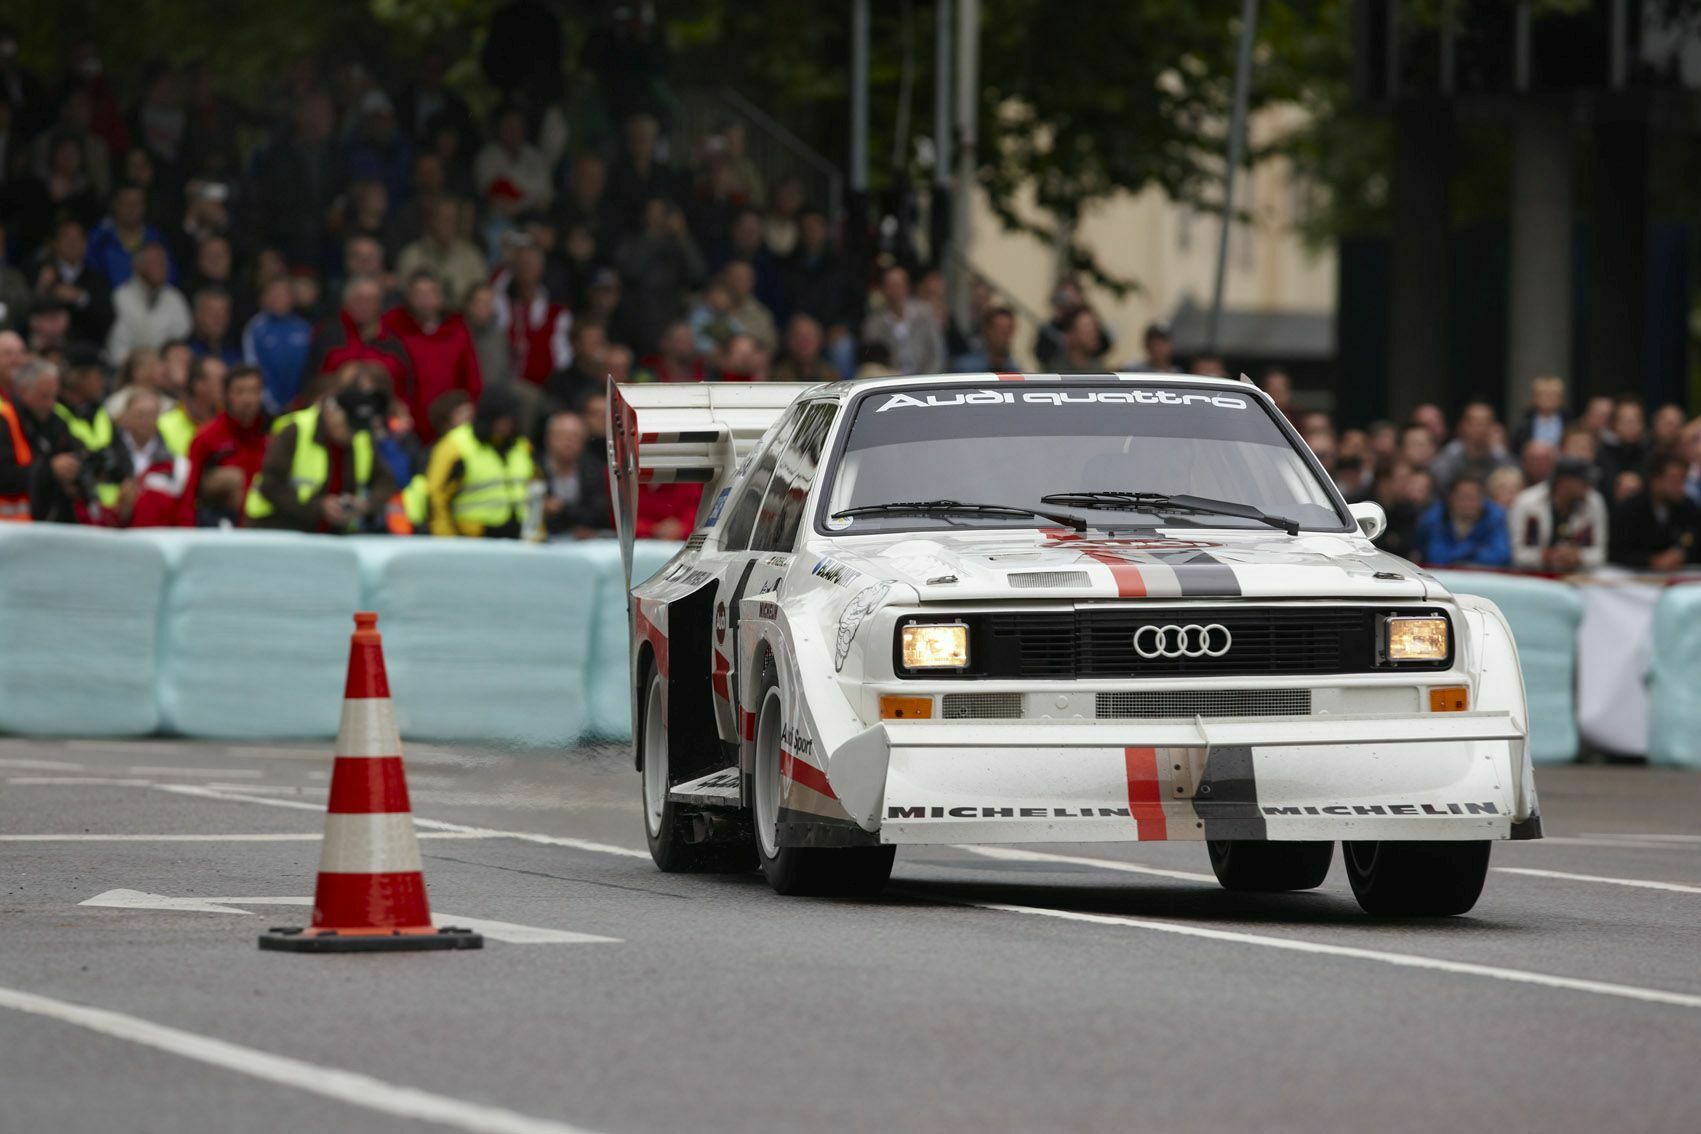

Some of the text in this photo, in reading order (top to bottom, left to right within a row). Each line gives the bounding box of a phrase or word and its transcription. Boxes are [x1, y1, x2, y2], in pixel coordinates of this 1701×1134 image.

[876, 389, 1247, 412] Audi quattro
[794, 729, 813, 755] Sport
[888, 806, 1131, 818] MICHELIN
[1262, 802, 1499, 815] MICHELIN
